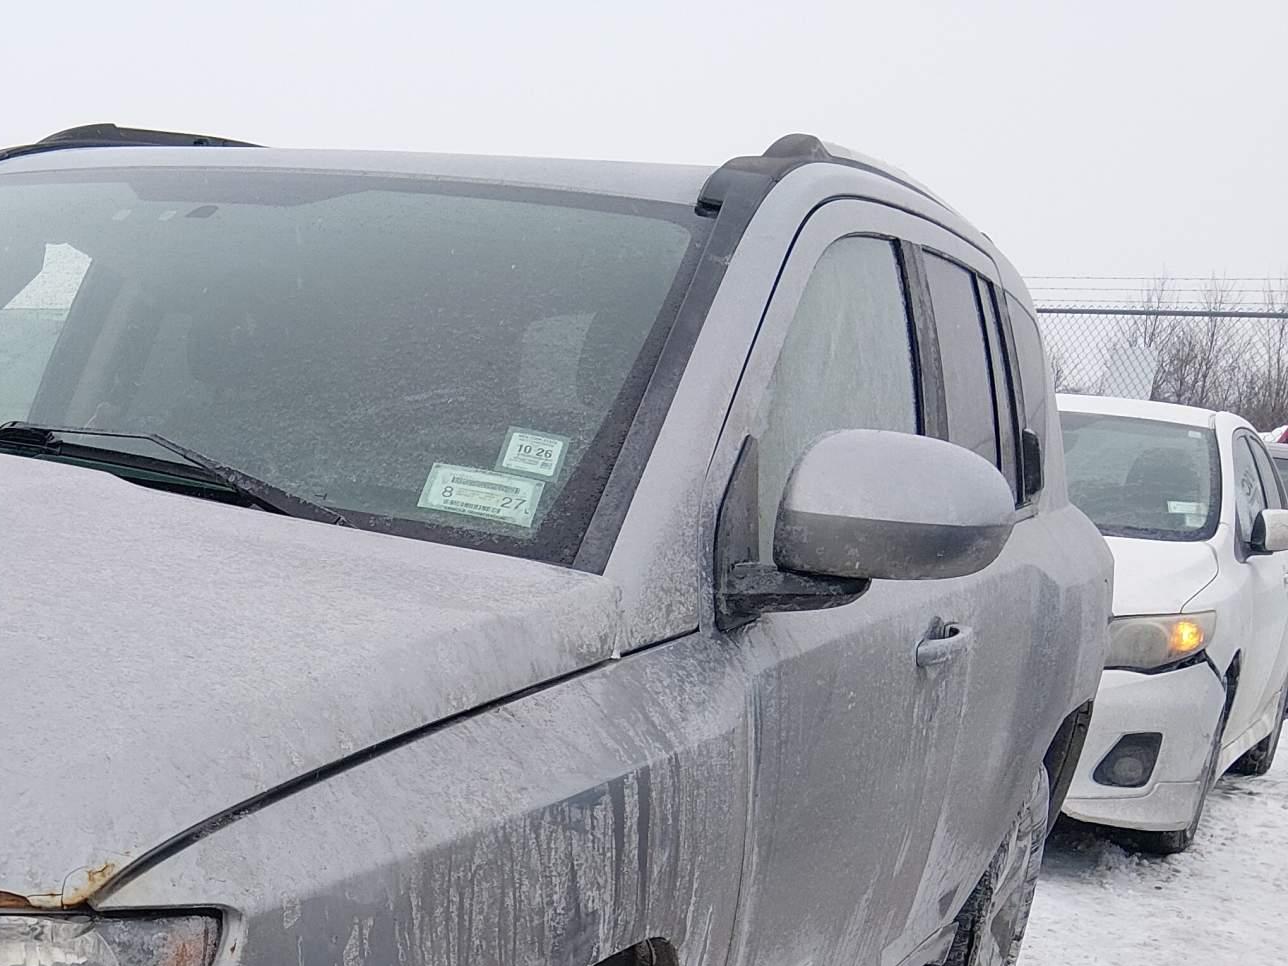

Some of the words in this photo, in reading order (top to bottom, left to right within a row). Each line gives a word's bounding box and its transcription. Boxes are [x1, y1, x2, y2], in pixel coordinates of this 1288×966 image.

[517, 444, 532, 454] 10
[535, 448, 552, 459] 26
[442, 486, 453, 498] 8
[500, 496, 527, 510] 27
